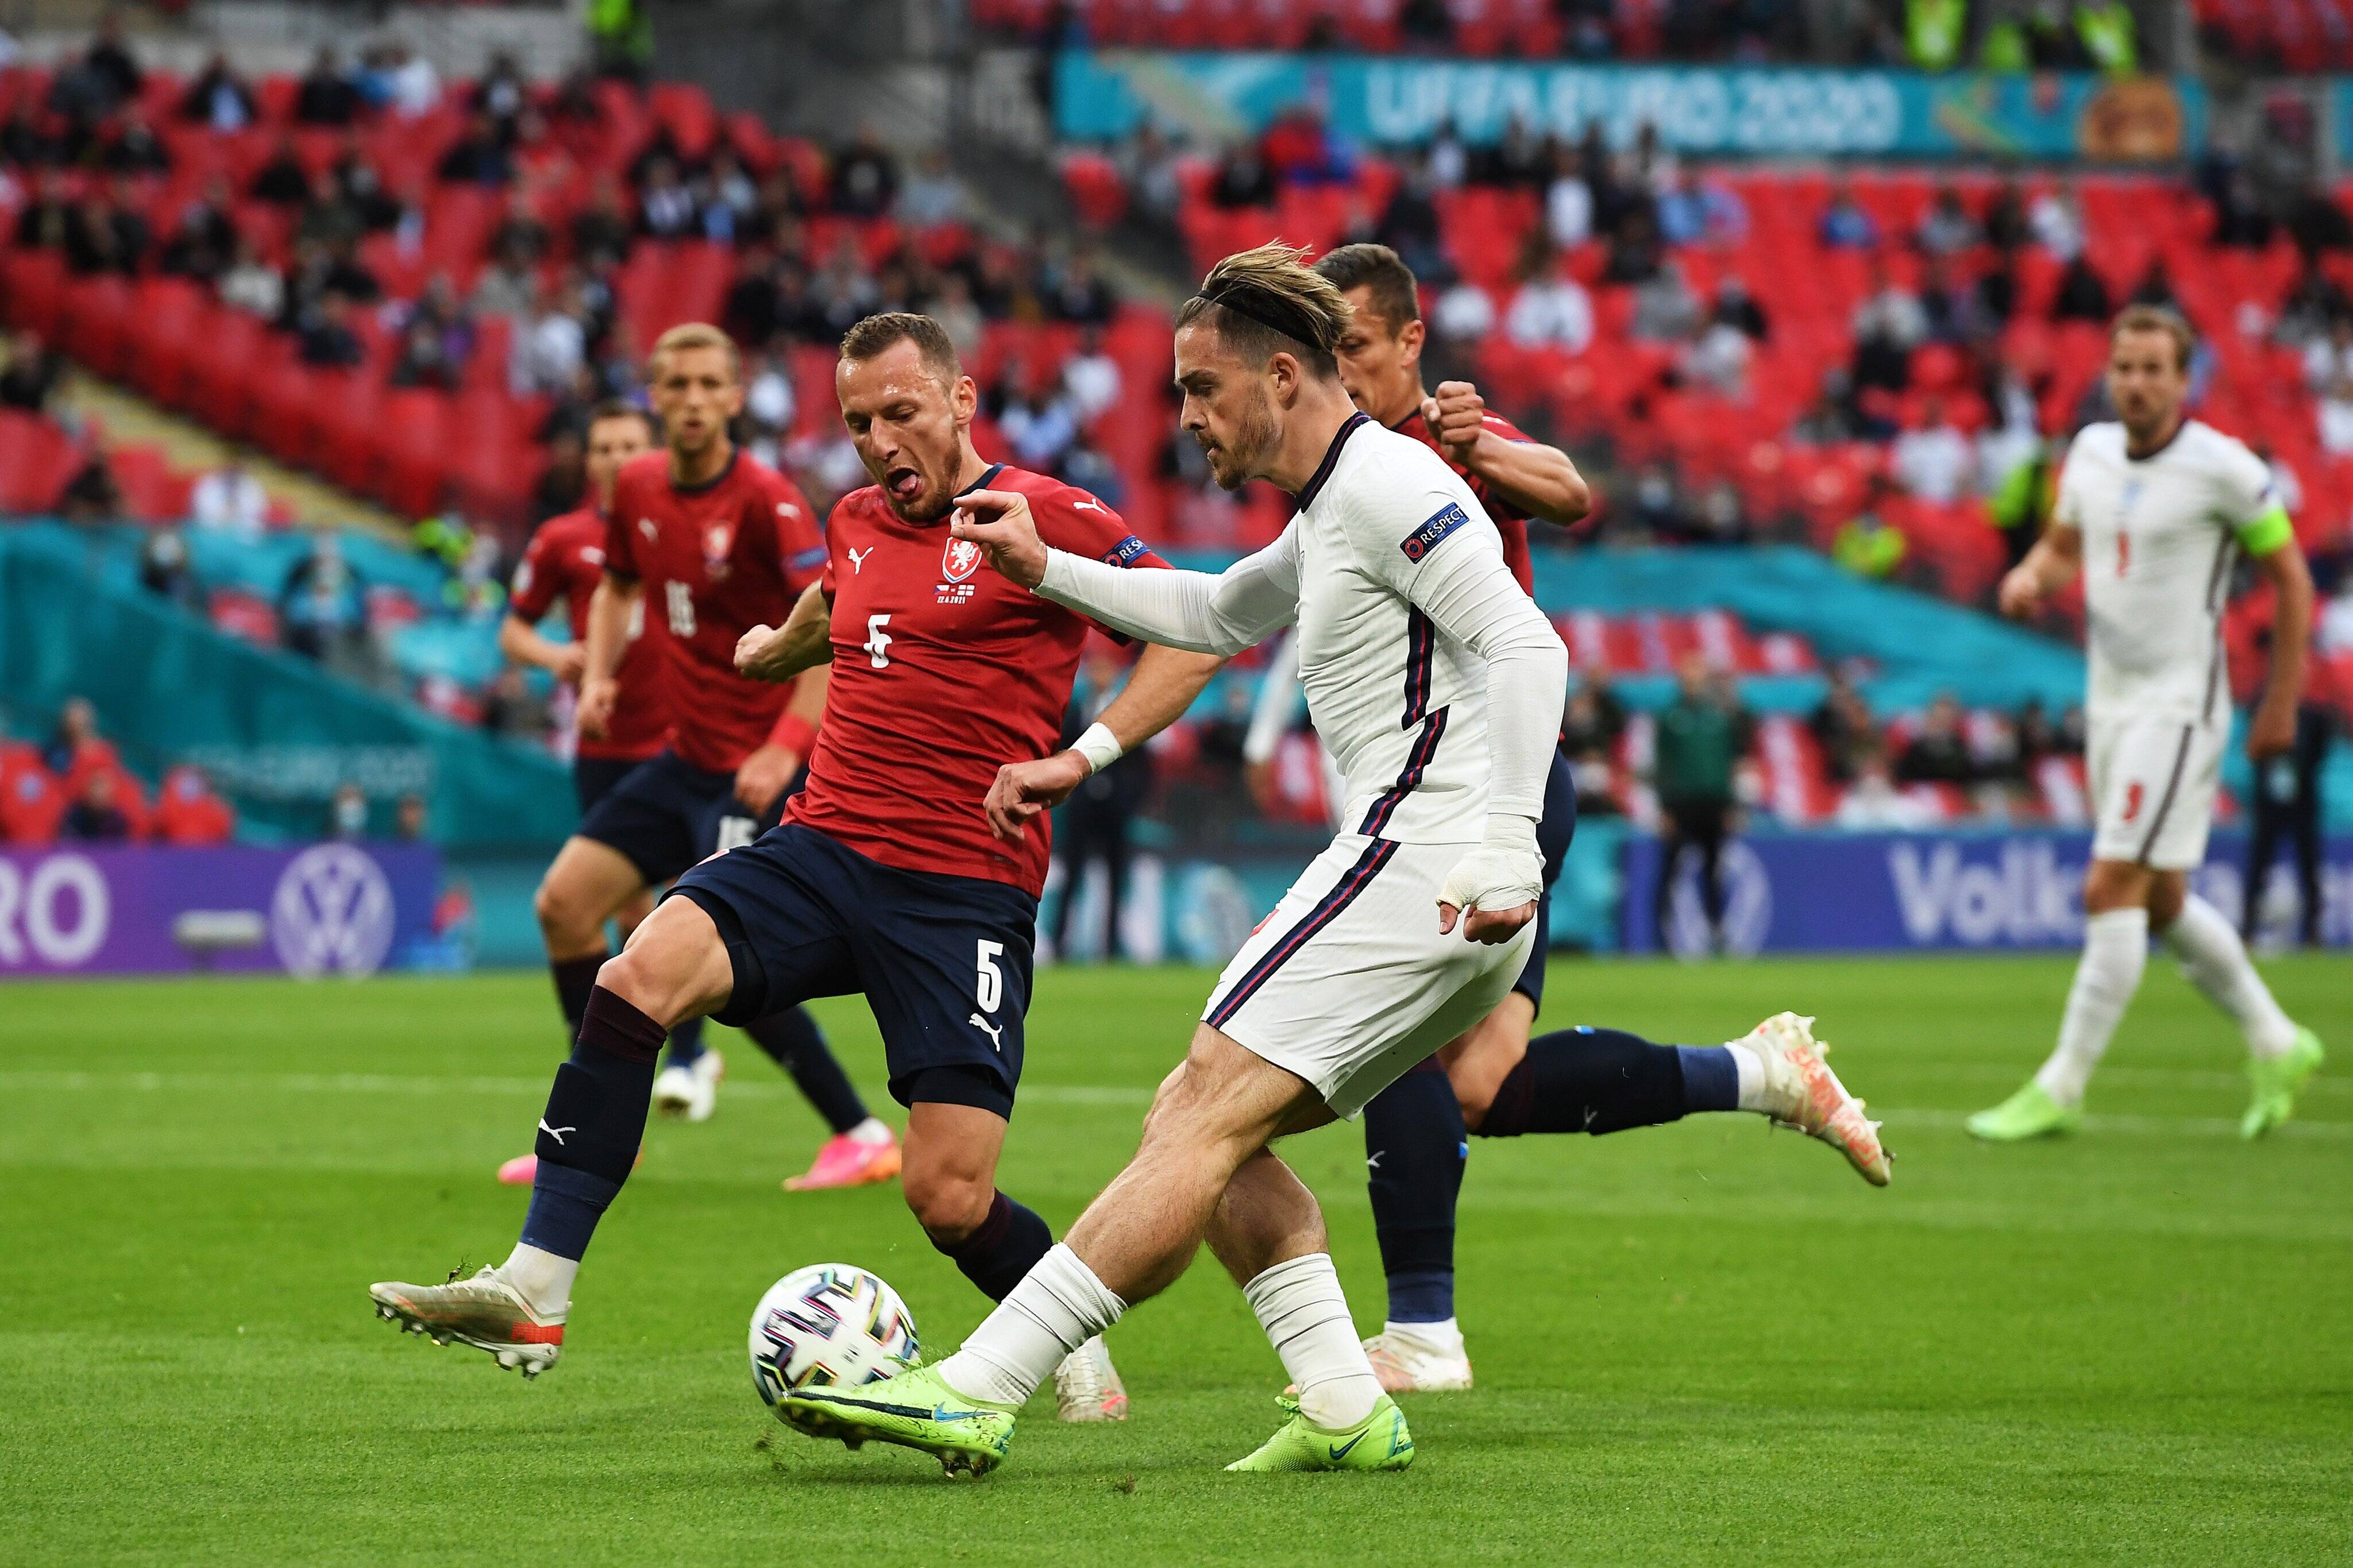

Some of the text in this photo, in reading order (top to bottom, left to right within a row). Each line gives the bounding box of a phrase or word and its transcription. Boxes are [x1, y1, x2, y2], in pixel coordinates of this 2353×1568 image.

[1736, 69, 1902, 150] 2020
[1420, 507, 1464, 544] RESPECT
[863, 614, 893, 669] 5
[977, 939, 1004, 1013] 5
